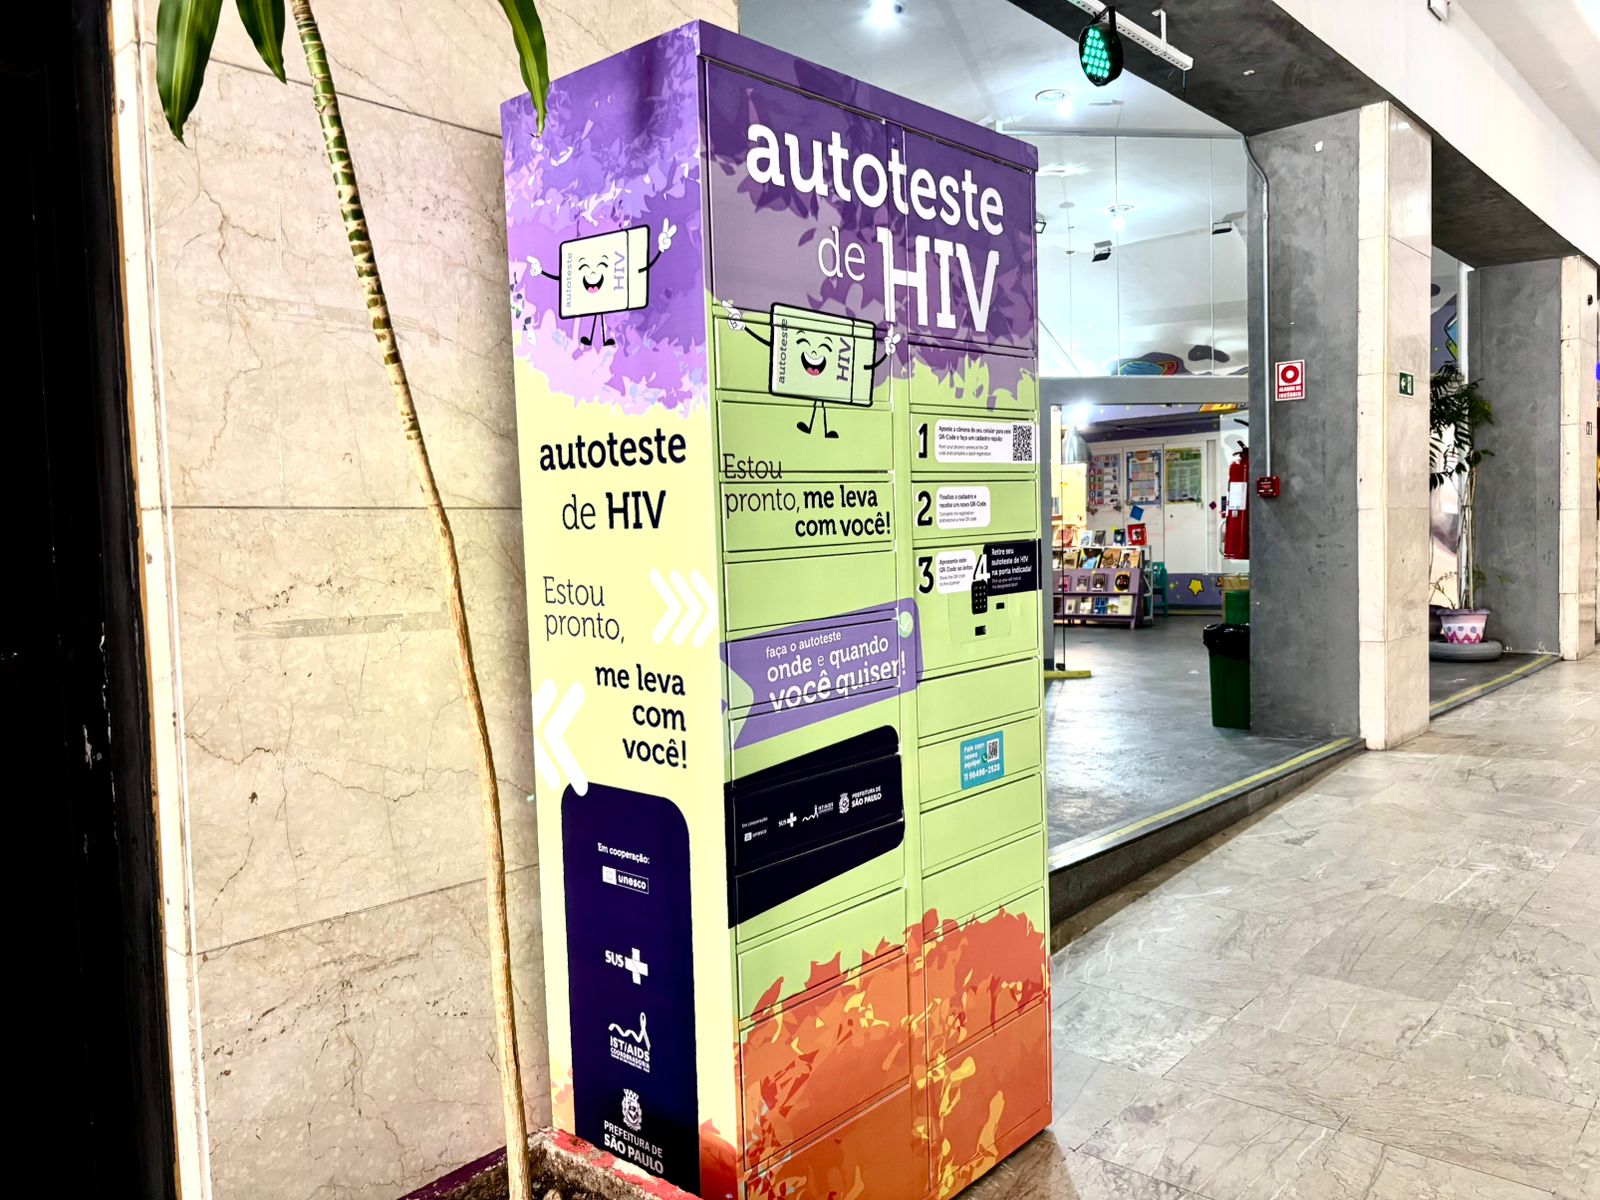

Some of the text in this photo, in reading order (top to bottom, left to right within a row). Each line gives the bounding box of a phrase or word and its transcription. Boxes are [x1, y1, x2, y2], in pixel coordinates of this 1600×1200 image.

[746, 123, 1004, 236] autoteste
[613, 250, 626, 291] HIV
[817, 226, 1000, 333] de HIV
[779, 318, 788, 384] autoteste
[836, 337, 852, 382] HIV
[540, 428, 687, 472] autoteste
[918, 423, 928, 459] 1
[722, 453, 783, 479] Estou
[562, 490, 667, 530] de HIV
[724, 484, 878, 519] pronto, me leva
[917, 491, 933, 526] 2
[795, 511, 891, 537] com você!
[918, 556, 934, 594] 3
[972, 554, 991, 582] 4
[991, 558, 1013, 567] autoteste
[543, 576, 605, 607] Estou
[544, 612, 625, 645] pronto,
[765, 631, 842, 660] faça o autoteste
[767, 635, 889, 683] onde e quando
[595, 663, 686, 696] me leva
[769, 650, 907, 713] você quiser!
[632, 704, 687, 732] com
[622, 738, 687, 769] você!
[851, 793, 882, 808] SÃO PAULO
[778, 819, 787, 827] SUS
[598, 842, 650, 864] Em cooperação:
[618, 874, 647, 890] unesco
[605, 949, 625, 968] SUS
[610, 1035, 650, 1062] IST/AIDS
[604, 1120, 663, 1159] PREFEITURA DE
[604, 1133, 664, 1175] SÃO PAULO
